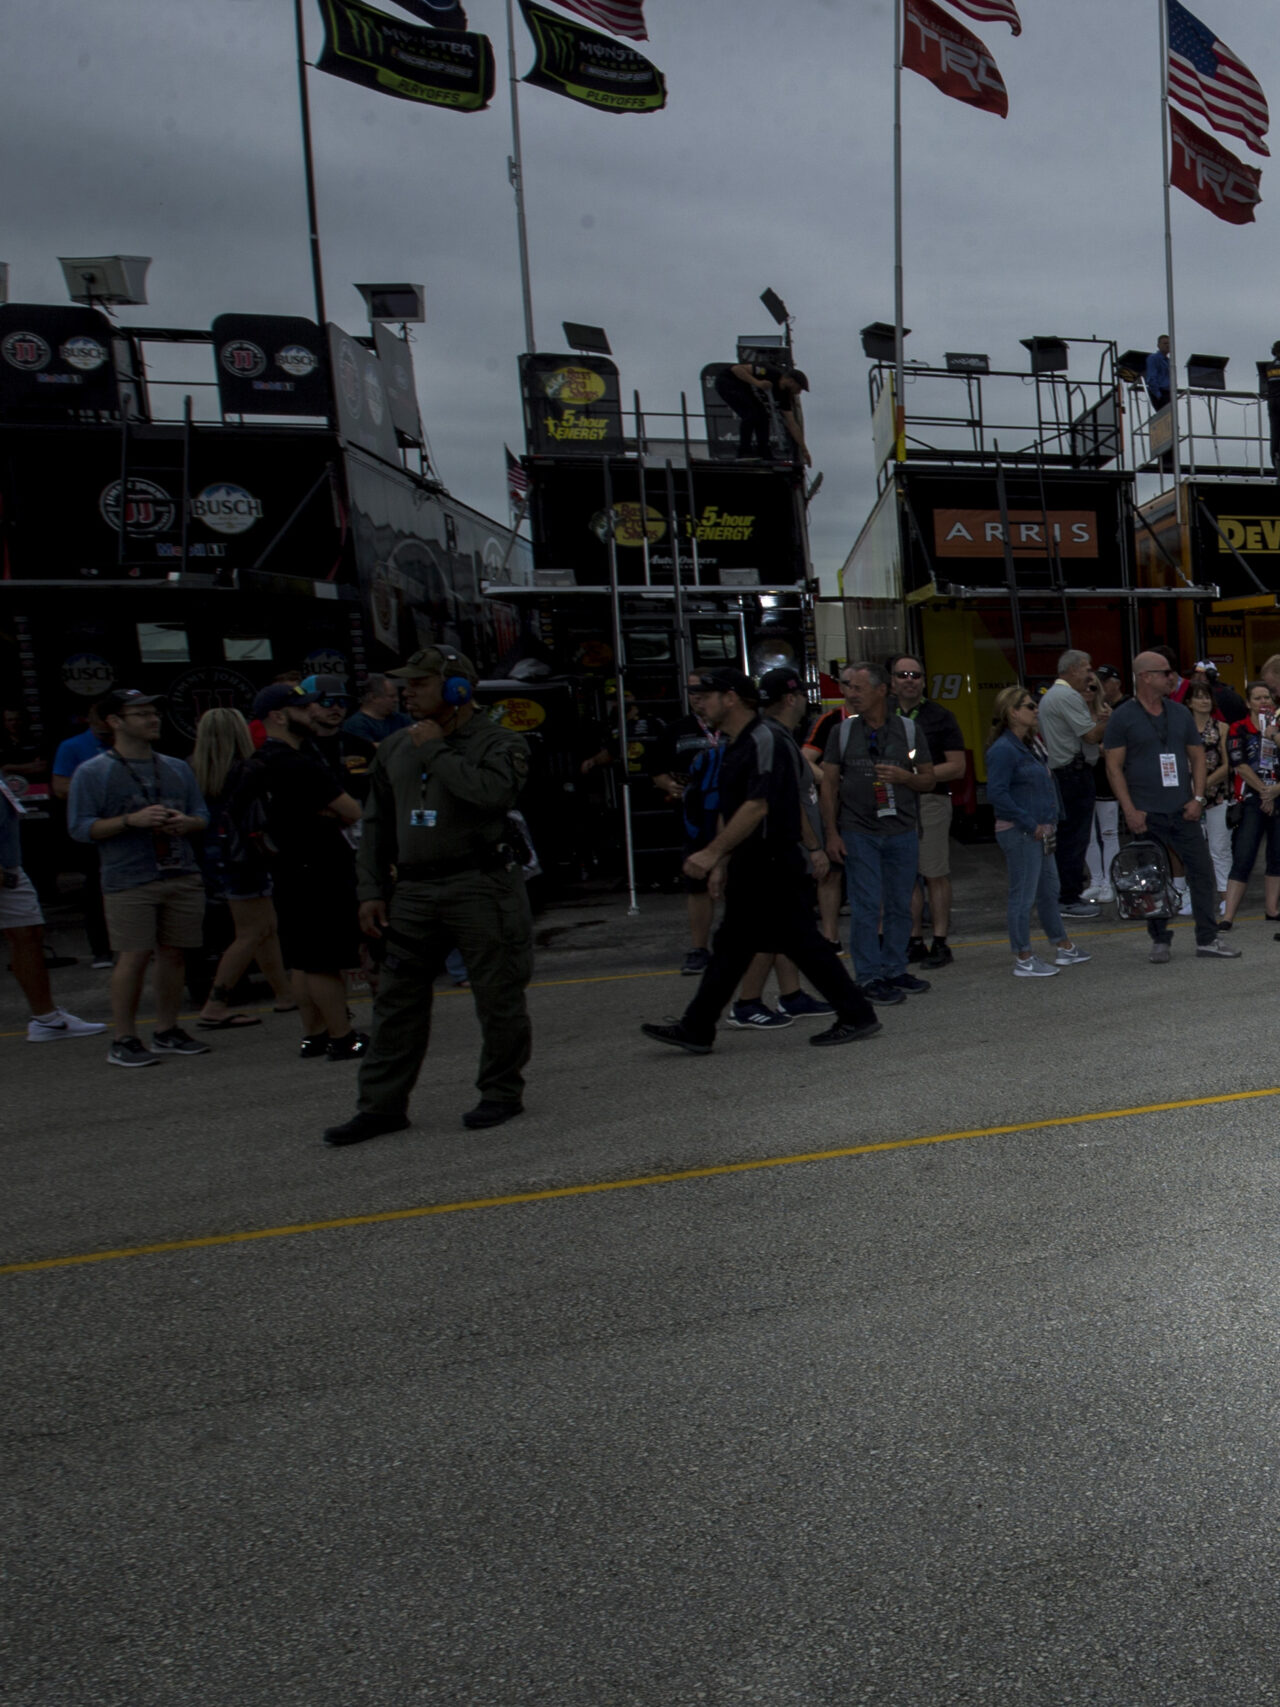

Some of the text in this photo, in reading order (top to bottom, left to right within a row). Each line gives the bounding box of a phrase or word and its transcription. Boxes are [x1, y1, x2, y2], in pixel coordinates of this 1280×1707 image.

[400, 79, 461, 101] PLAYOFFS
[586, 91, 647, 107] PLAYOFFS
[193, 500, 262, 517] BUSCH
[700, 505, 756, 527] 5-hour
[695, 526, 754, 541] ENERGY
[944, 522, 1091, 542] ARRIS
[931, 674, 963, 699] 19
